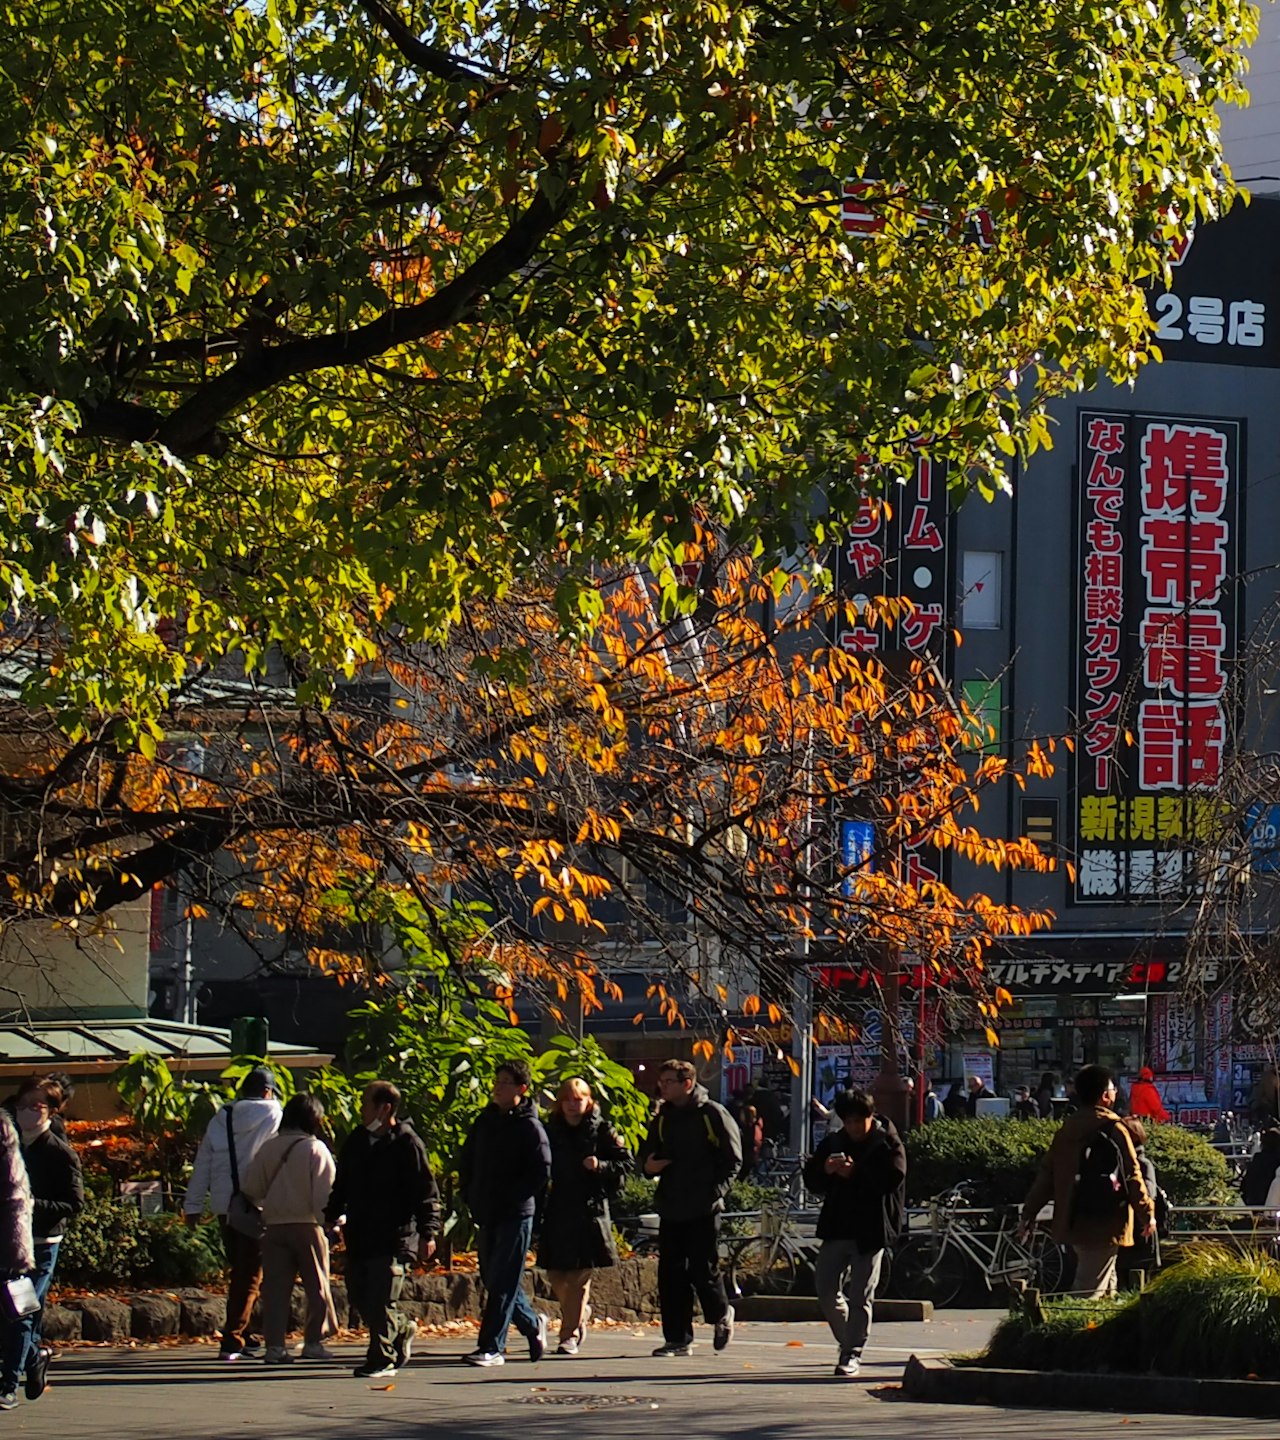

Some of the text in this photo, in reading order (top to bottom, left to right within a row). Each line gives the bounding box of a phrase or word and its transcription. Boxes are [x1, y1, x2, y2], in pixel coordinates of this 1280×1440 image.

[1153, 292, 1267, 348] 2号店
[1084, 418, 1125, 791] なんでも相談カウンター
[1138, 422, 1230, 793] 携帯電話
[1166, 961, 1218, 984] 2店
